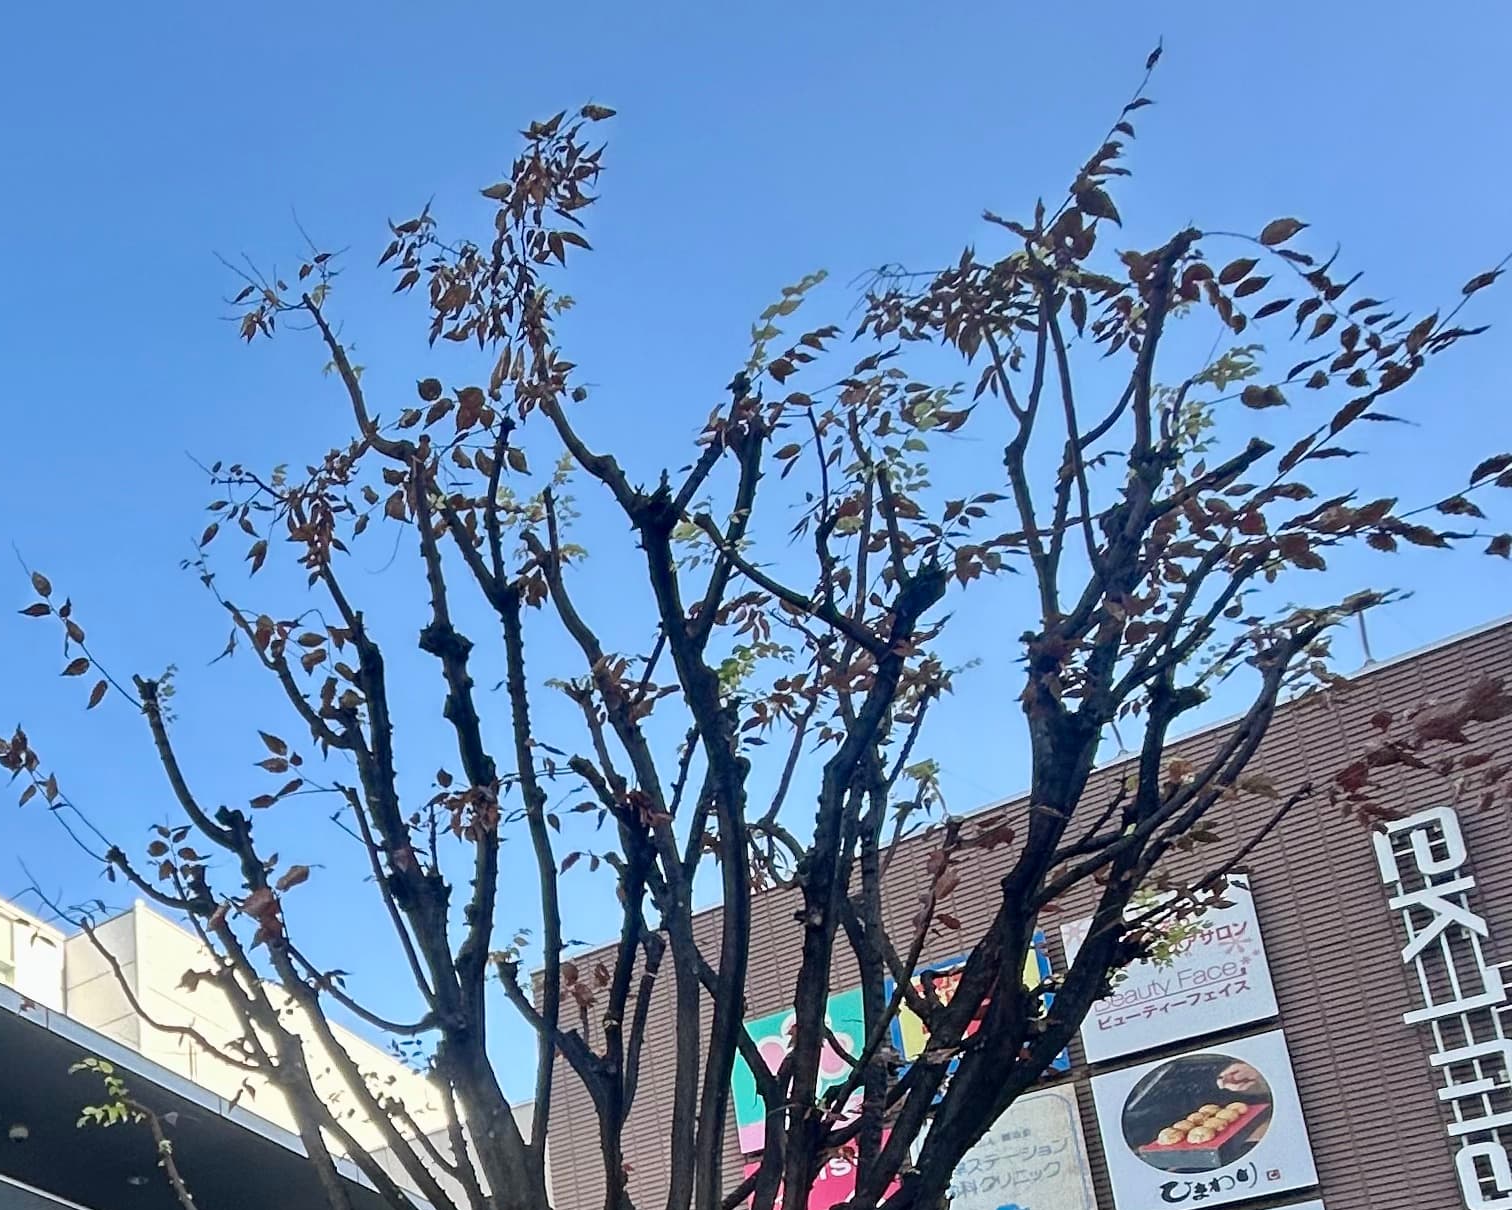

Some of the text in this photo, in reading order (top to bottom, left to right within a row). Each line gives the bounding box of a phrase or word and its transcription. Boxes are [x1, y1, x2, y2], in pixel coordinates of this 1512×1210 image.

[1177, 961, 1237, 988] Face
[1097, 980, 1251, 1031] ビューティーフェイス
[1159, 1161, 1258, 1203] ひまわり
